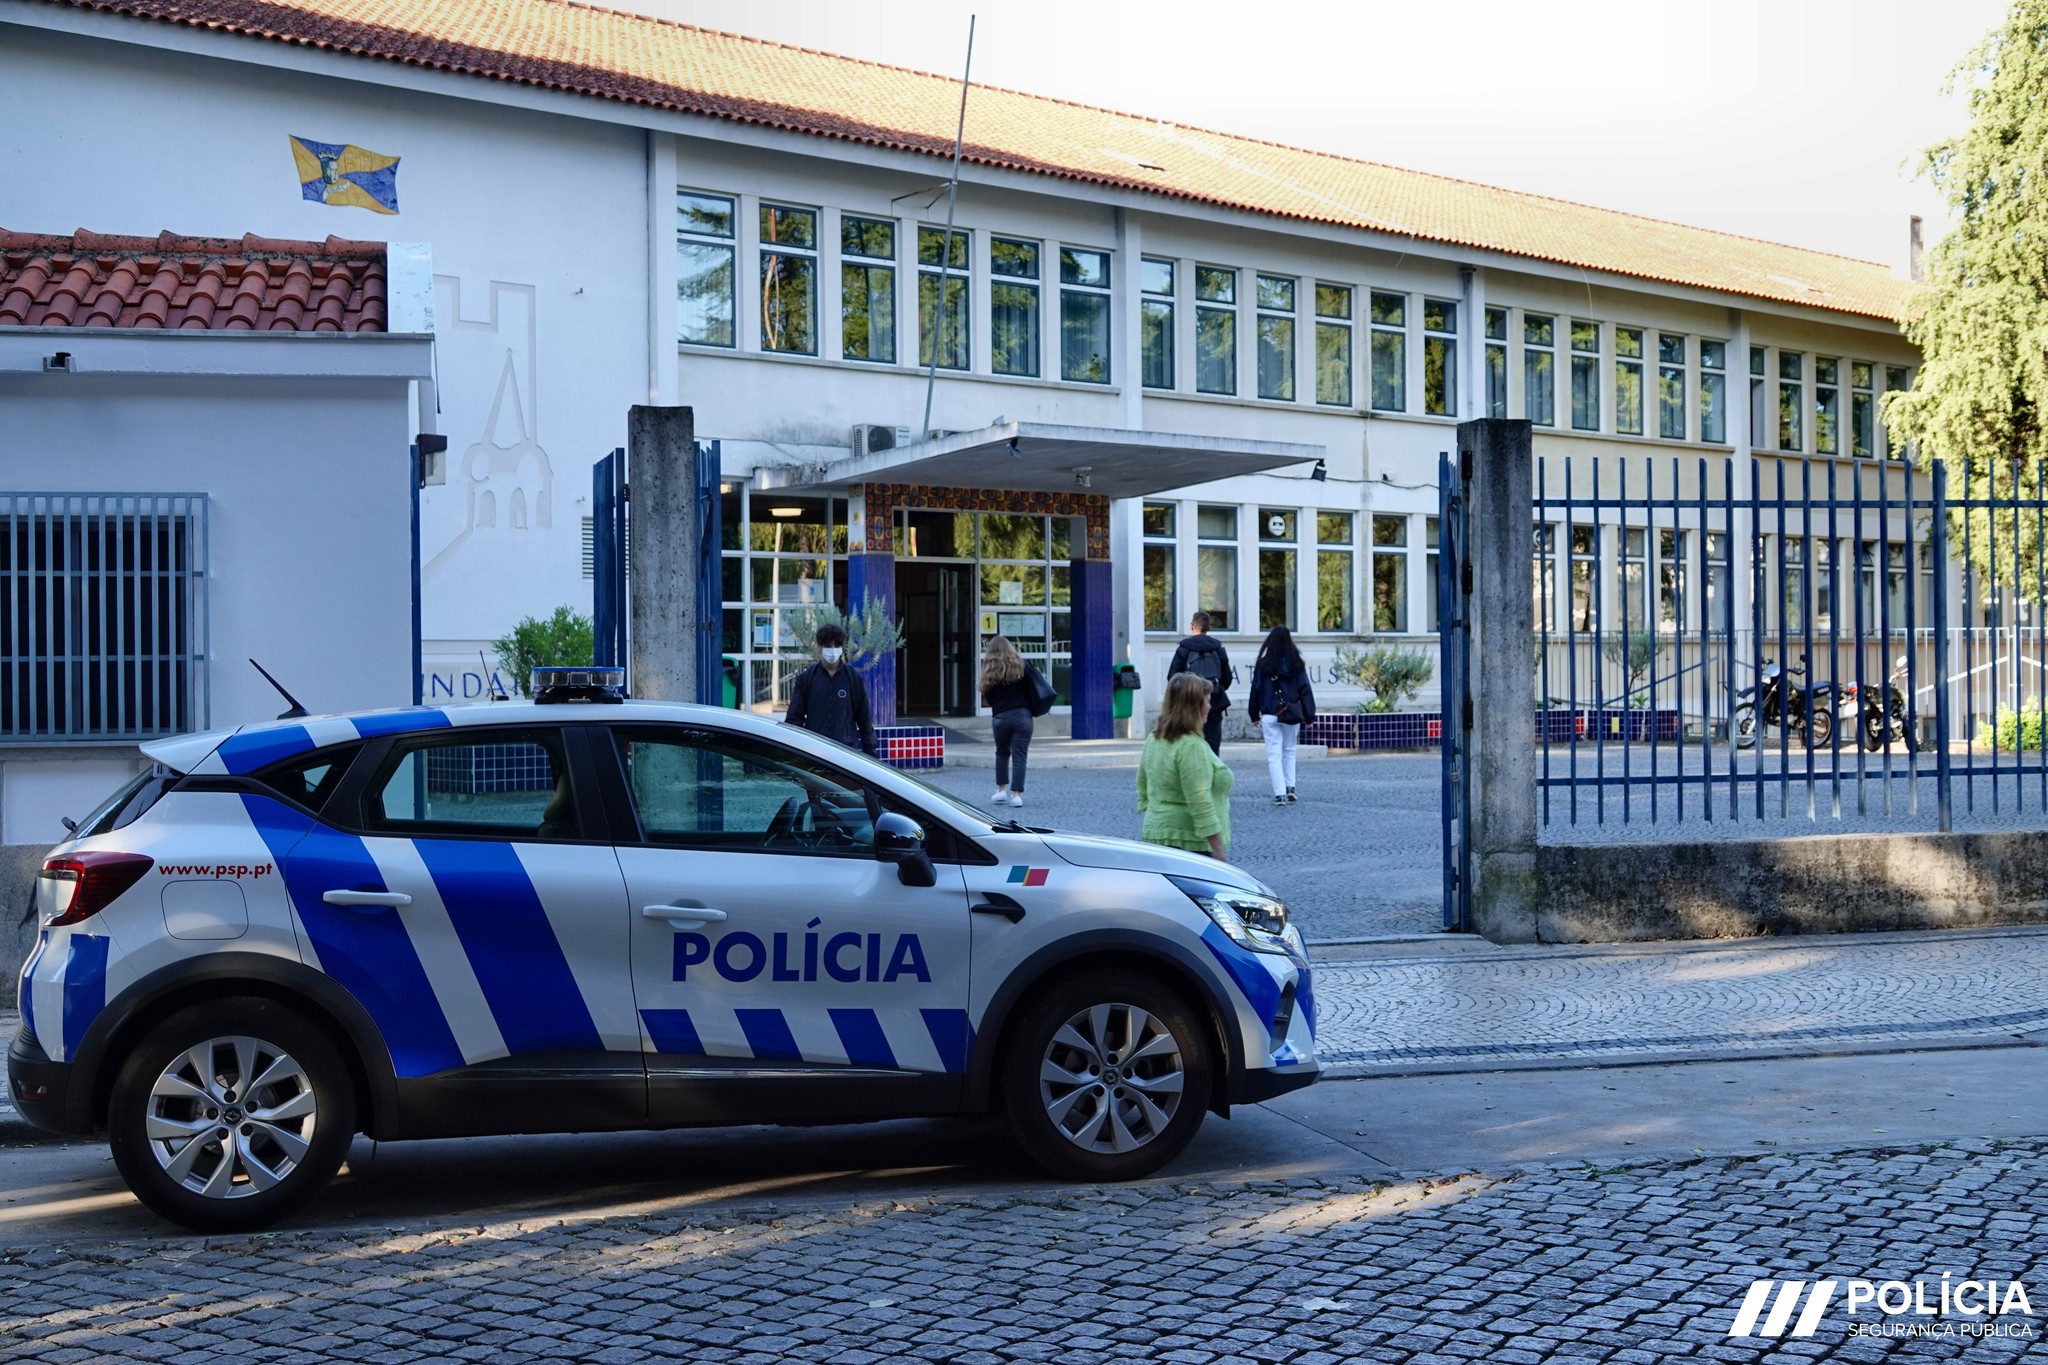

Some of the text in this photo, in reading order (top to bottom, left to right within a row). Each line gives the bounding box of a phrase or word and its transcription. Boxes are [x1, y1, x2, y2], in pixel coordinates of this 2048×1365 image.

[985, 616, 991, 629] 1
[159, 863, 273, 879] www.psp.pt
[672, 916, 932, 983] POLÍCIA
